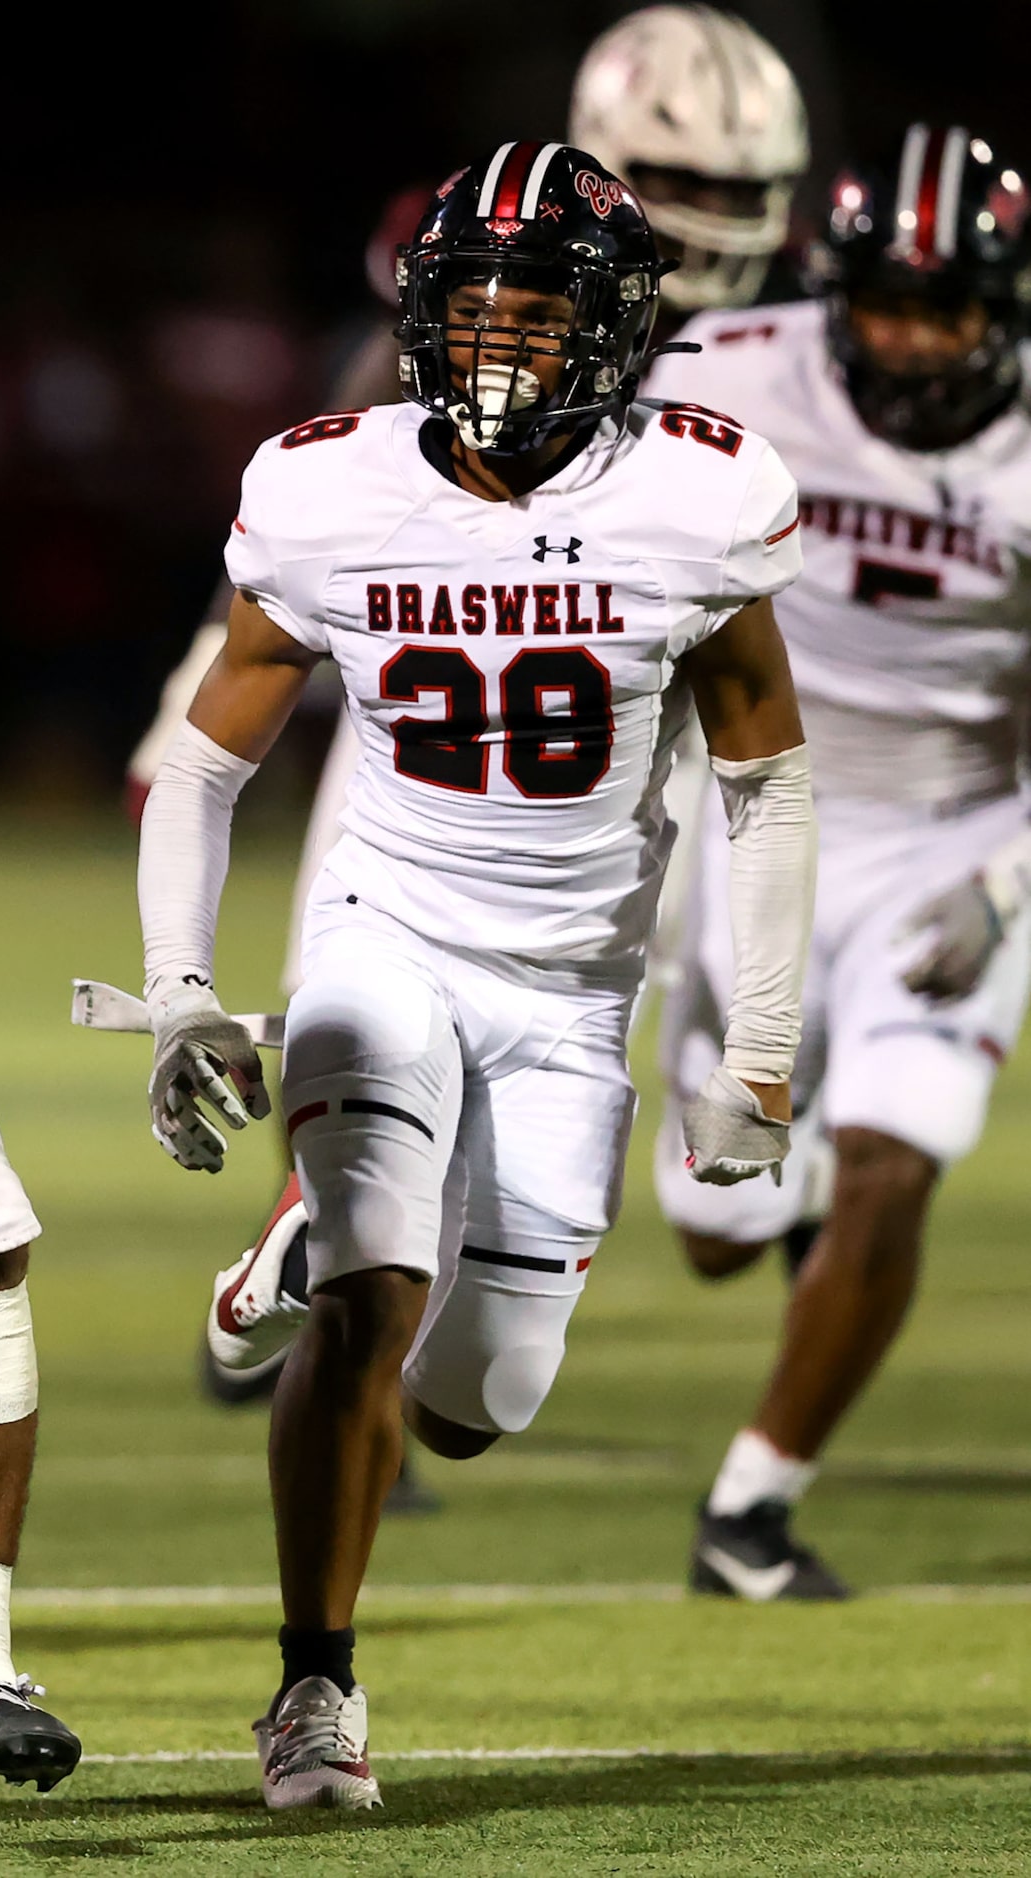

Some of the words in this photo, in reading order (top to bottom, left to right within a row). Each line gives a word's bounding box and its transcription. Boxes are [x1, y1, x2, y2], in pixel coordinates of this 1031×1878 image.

[280, 405, 373, 450] 8
[366, 583, 625, 636] BRASWELL
[379, 644, 616, 799] 28
